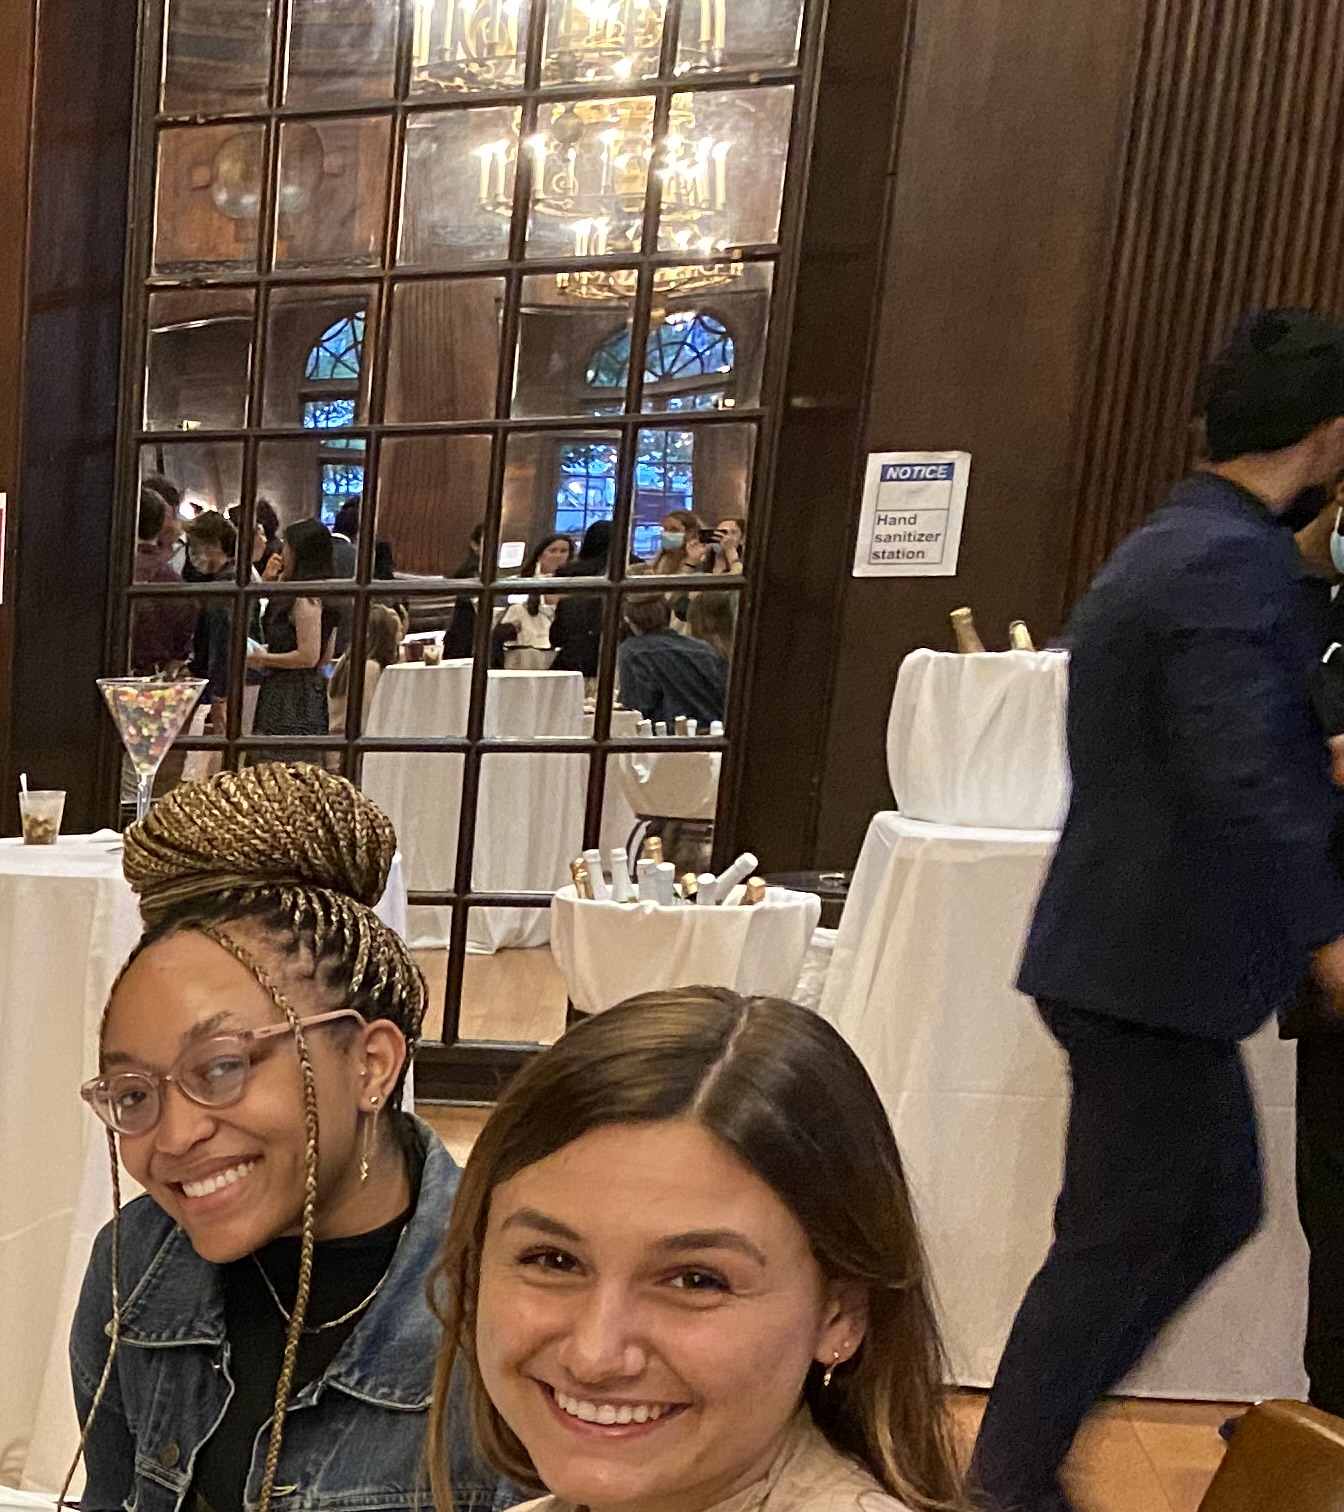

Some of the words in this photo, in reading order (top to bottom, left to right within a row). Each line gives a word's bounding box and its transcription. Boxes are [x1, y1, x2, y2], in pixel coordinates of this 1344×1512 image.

[886, 466, 949, 480] NOTICE
[877, 514, 918, 526] Hand
[874, 531, 941, 543] sanitizer
[872, 548, 925, 560] station
